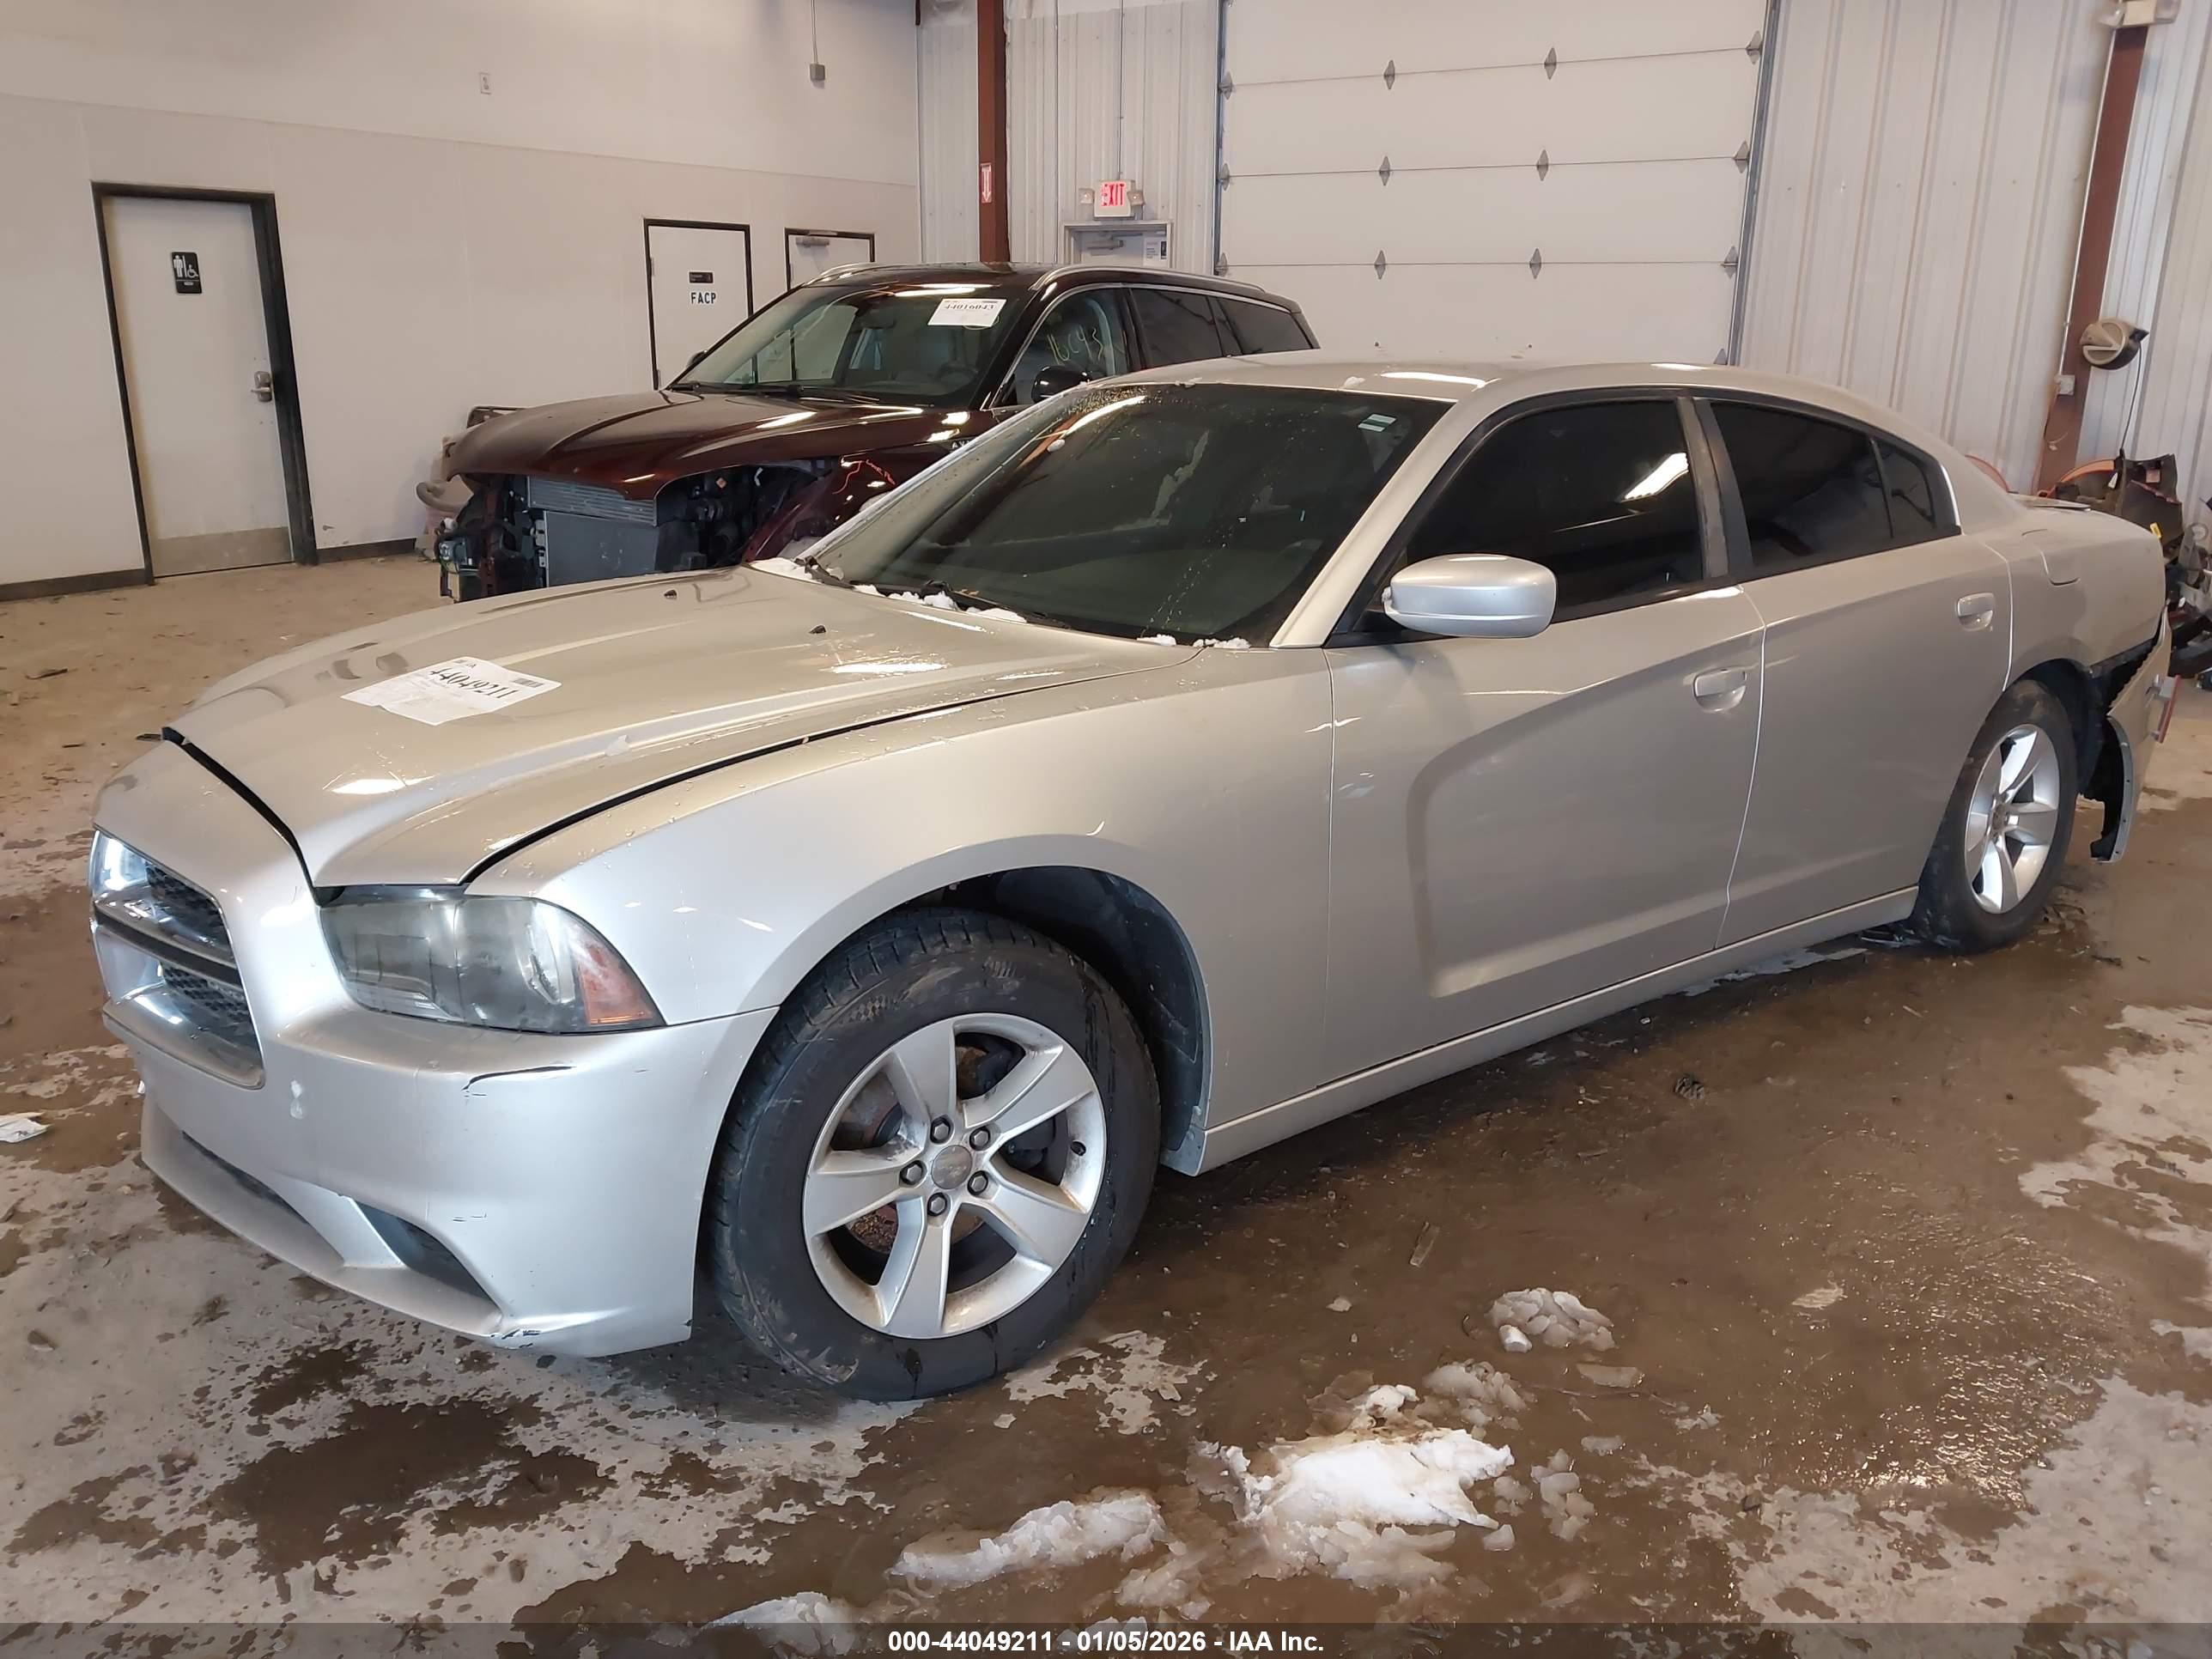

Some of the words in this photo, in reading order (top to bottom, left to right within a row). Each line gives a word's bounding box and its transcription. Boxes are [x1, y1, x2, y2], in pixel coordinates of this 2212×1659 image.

[1101, 183, 1125, 206] EXIT
[690, 292, 716, 304] FACP
[429, 667, 520, 699] 44049211
